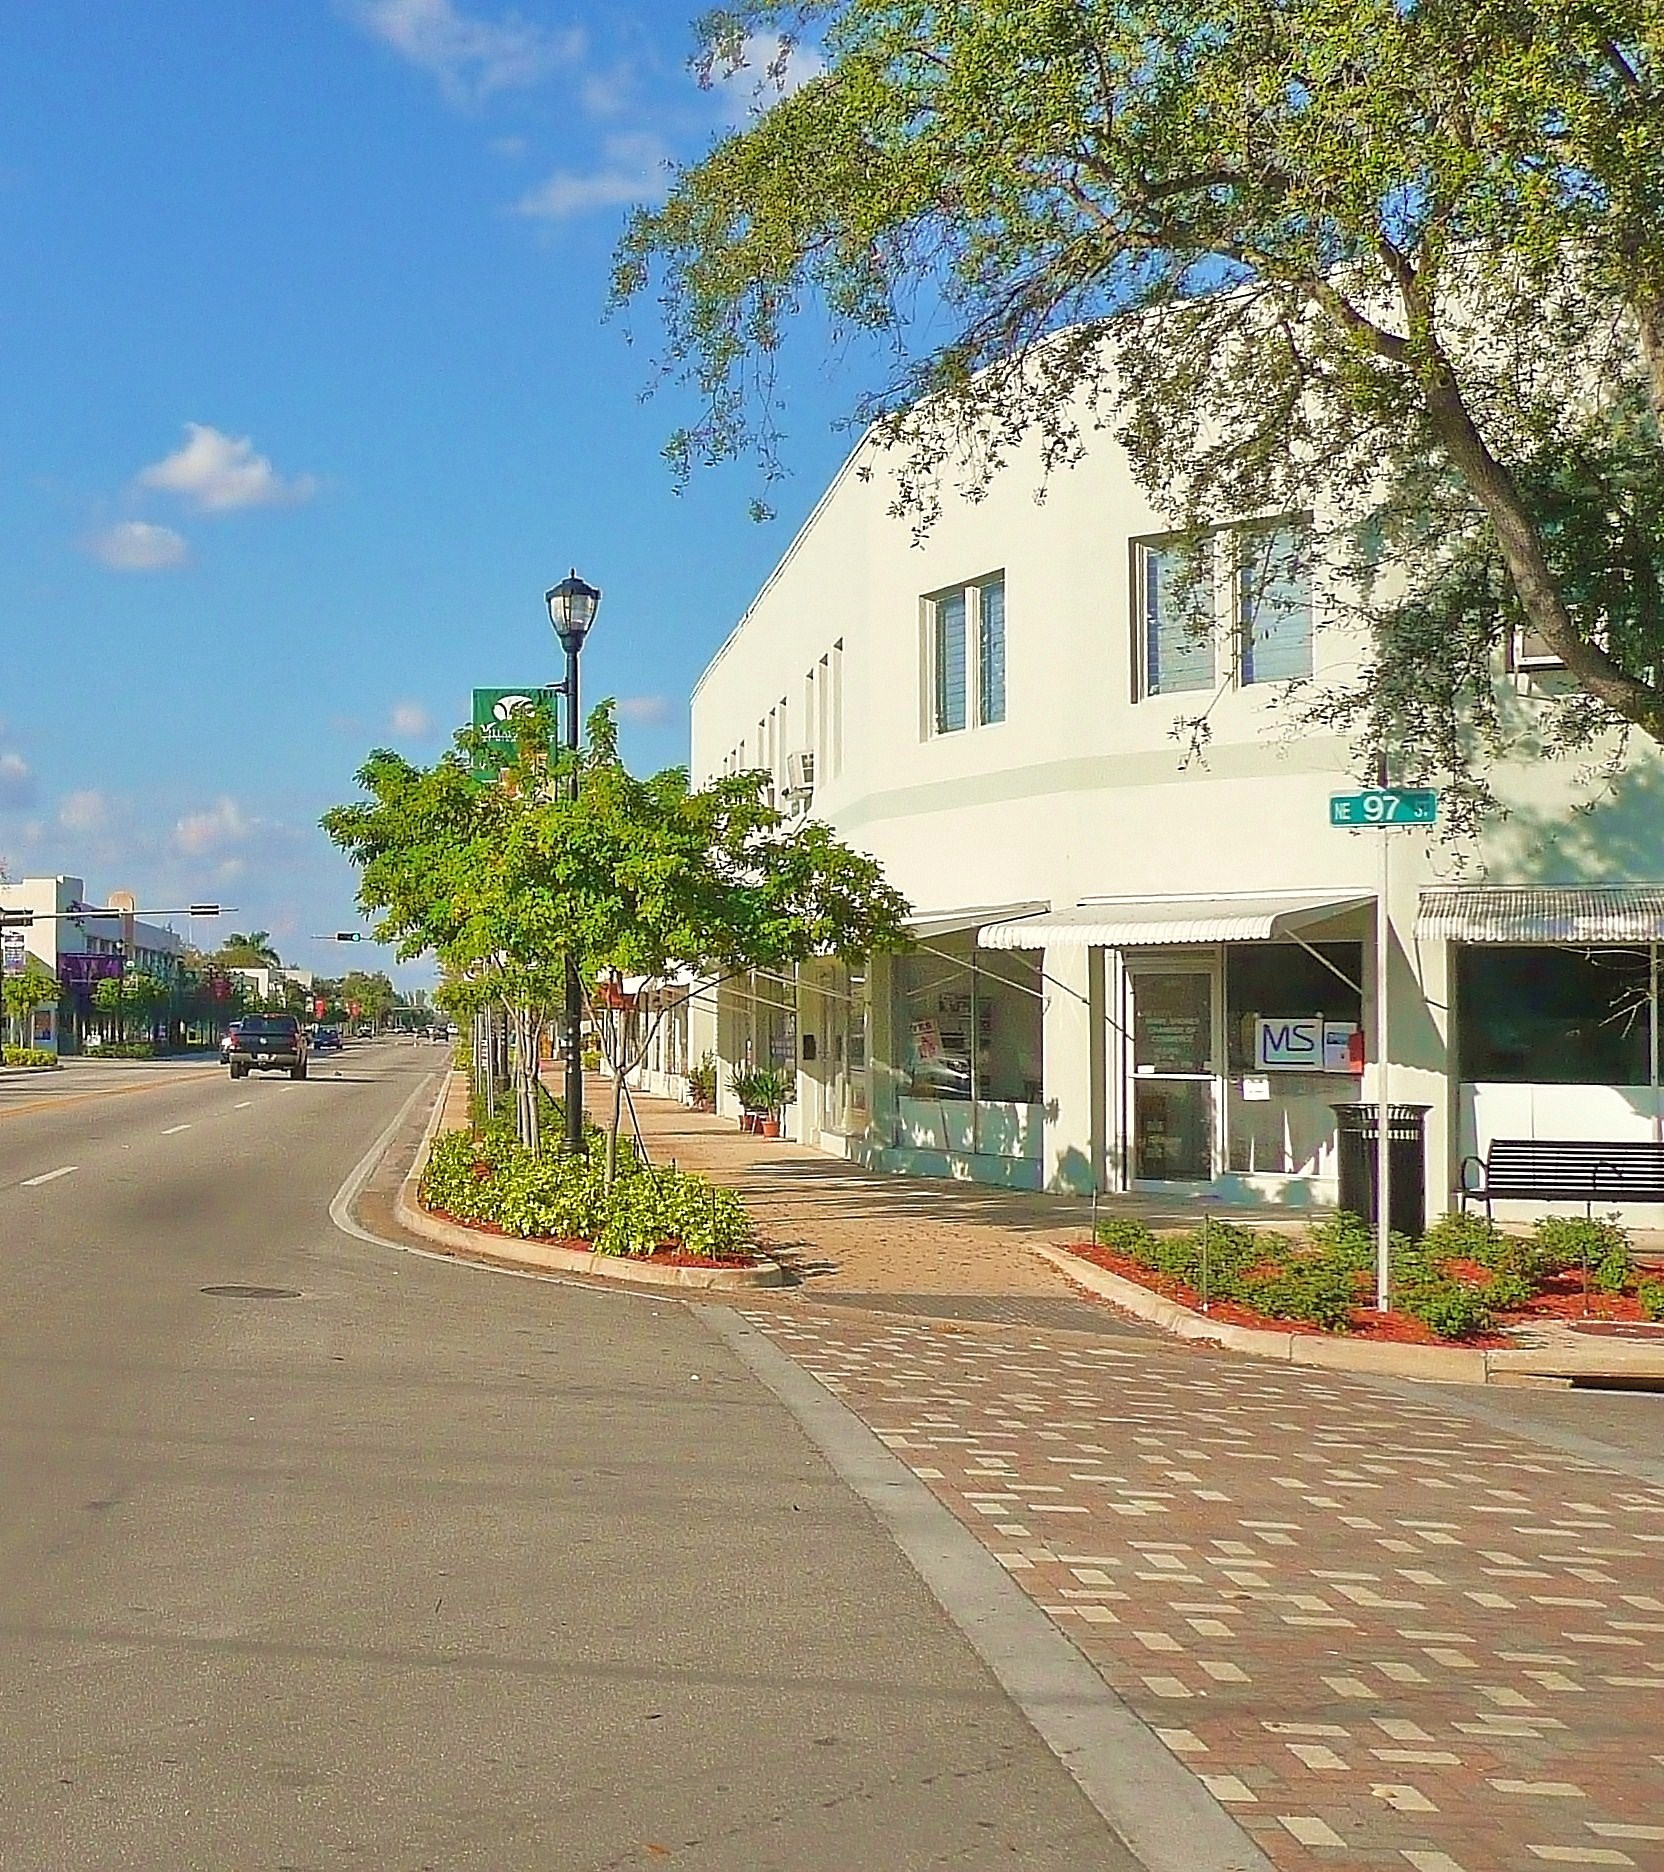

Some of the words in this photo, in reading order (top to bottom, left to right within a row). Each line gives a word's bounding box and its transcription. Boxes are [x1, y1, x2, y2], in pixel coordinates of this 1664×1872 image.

[1335, 802, 1351, 820] NE
[1363, 795, 1400, 821] 97
[1262, 1023, 1315, 1065] MS
